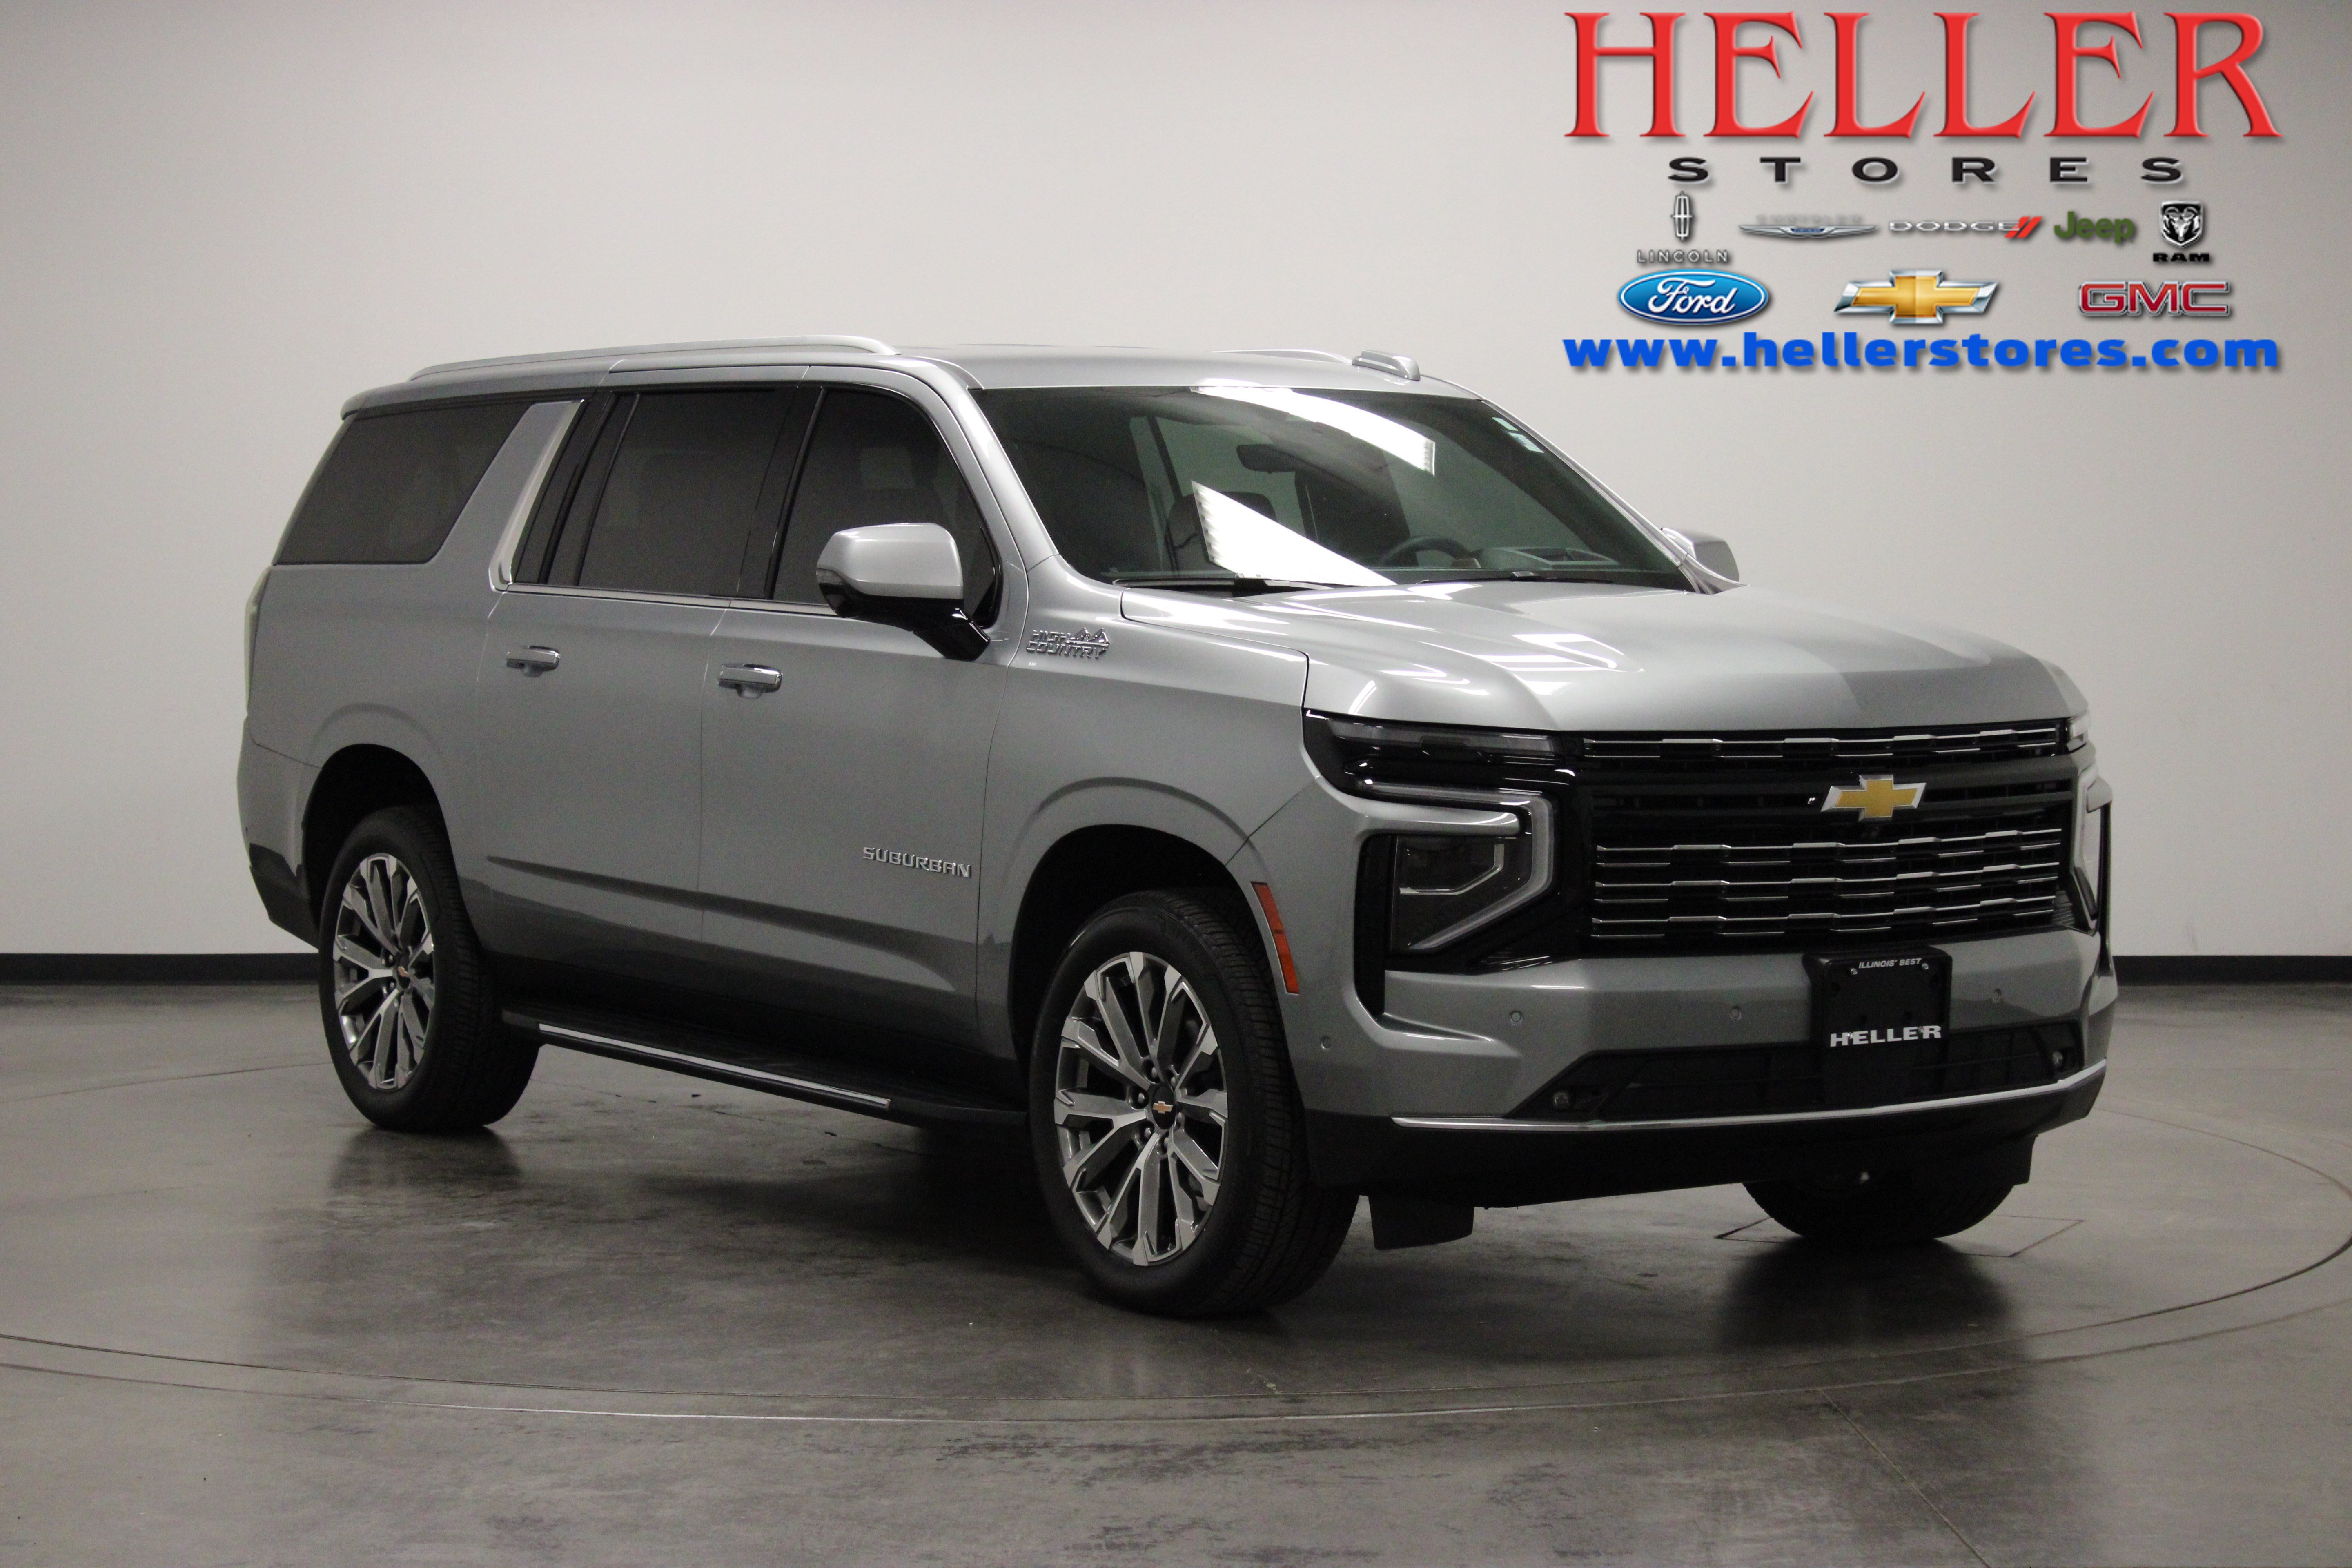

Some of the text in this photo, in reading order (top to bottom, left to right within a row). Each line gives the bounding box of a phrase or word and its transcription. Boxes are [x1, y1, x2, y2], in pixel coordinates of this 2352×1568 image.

[1026, 641, 1107, 659] COUNTRY
[863, 846, 970, 878] SUBURBAN
[1859, 958, 1922, 969] ILLINOIS' BEST
[1830, 1025, 1941, 1047] HELLER
